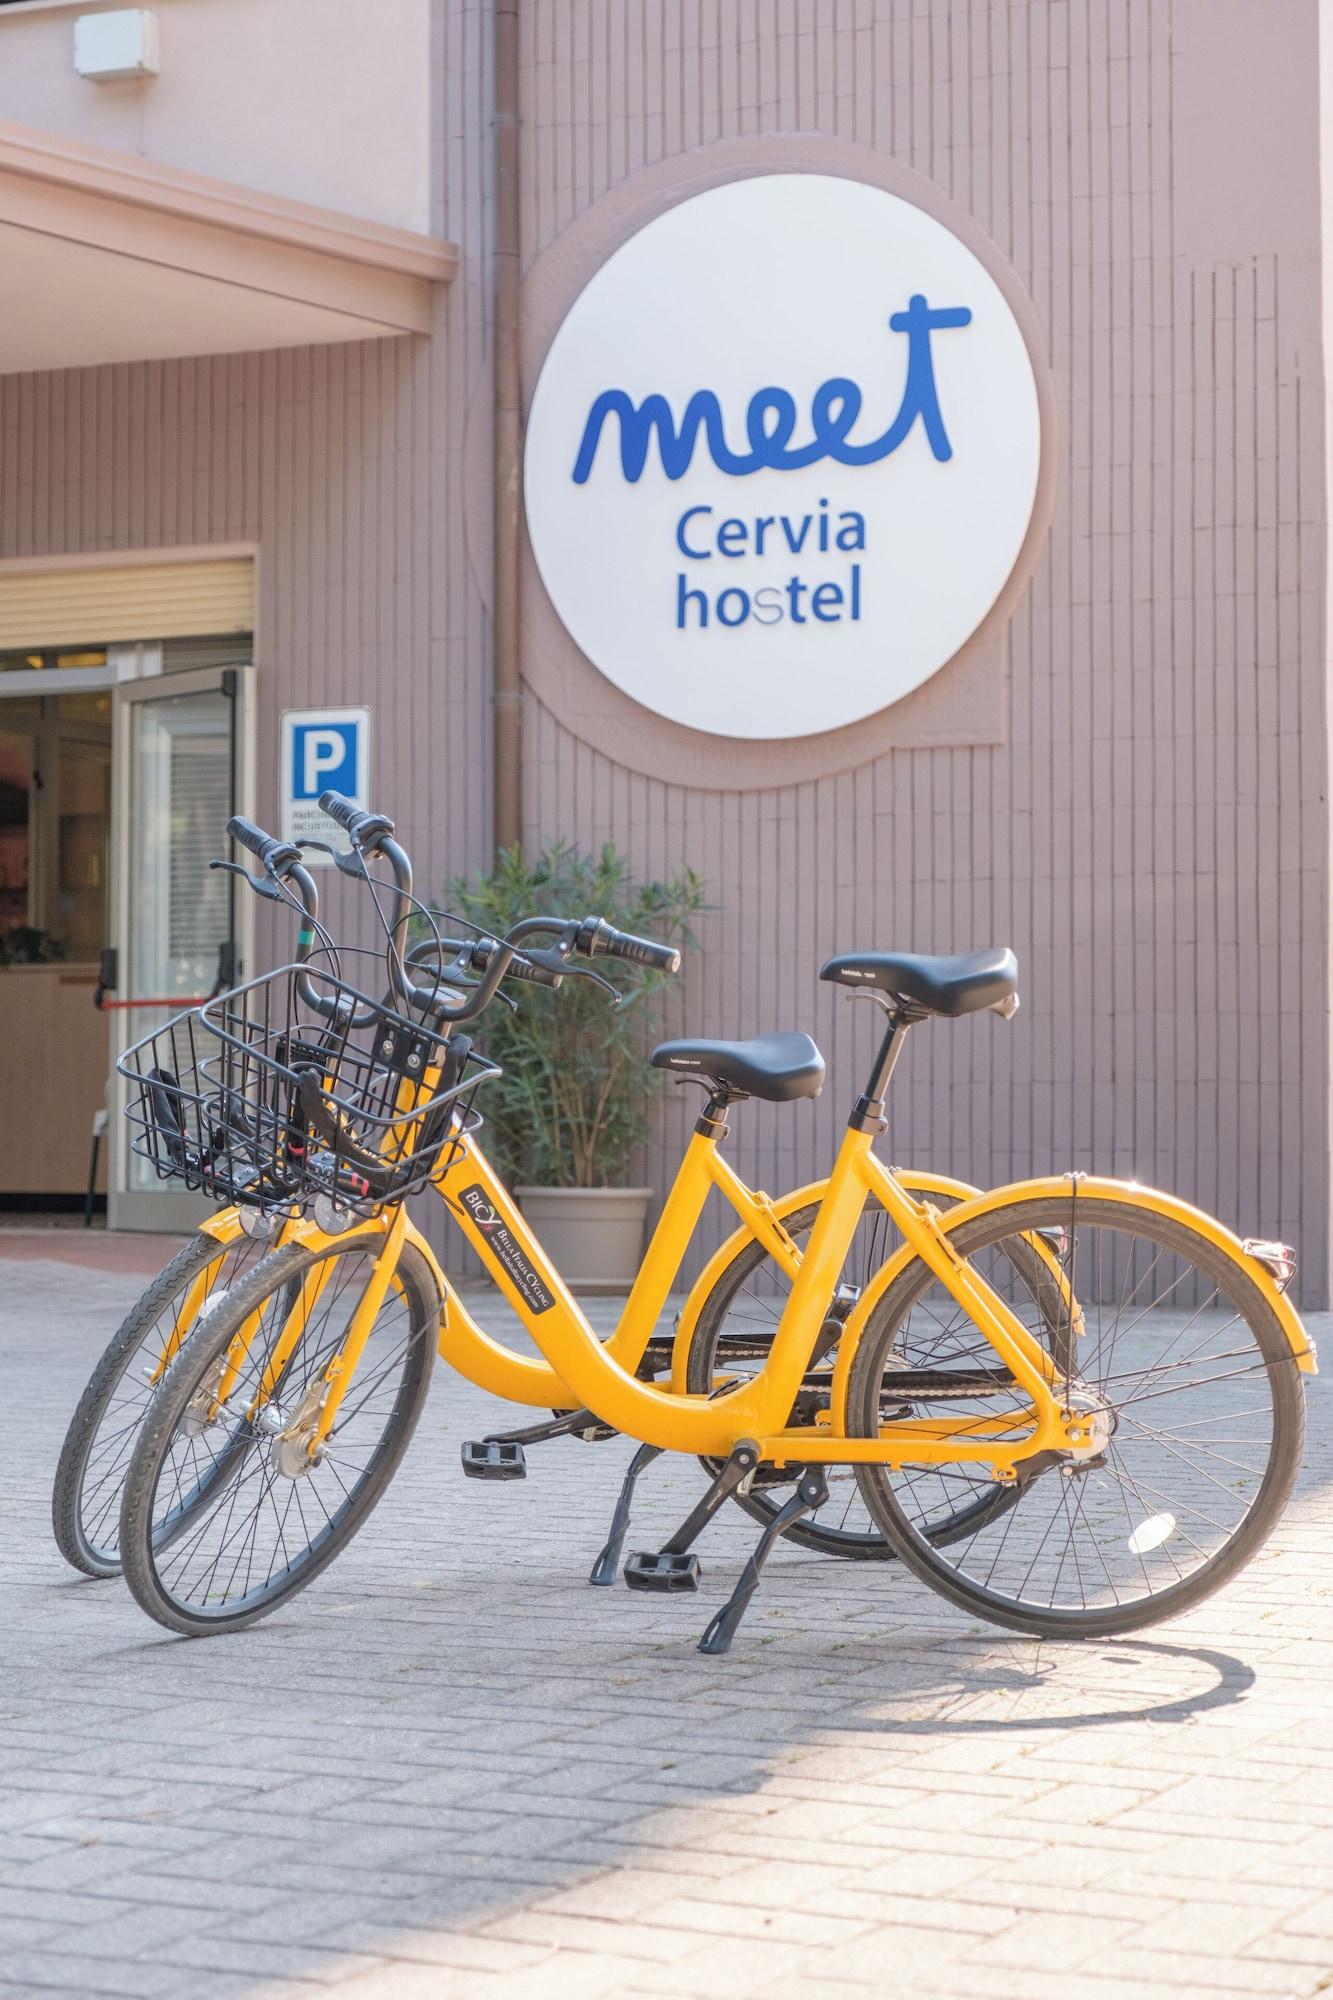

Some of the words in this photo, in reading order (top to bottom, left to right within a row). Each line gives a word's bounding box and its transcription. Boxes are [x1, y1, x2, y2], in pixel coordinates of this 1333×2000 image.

[572, 294, 972, 485] meet
[676, 498, 866, 560] Cervia
[676, 564, 861, 628] hostel
[304, 730, 346, 794] P
